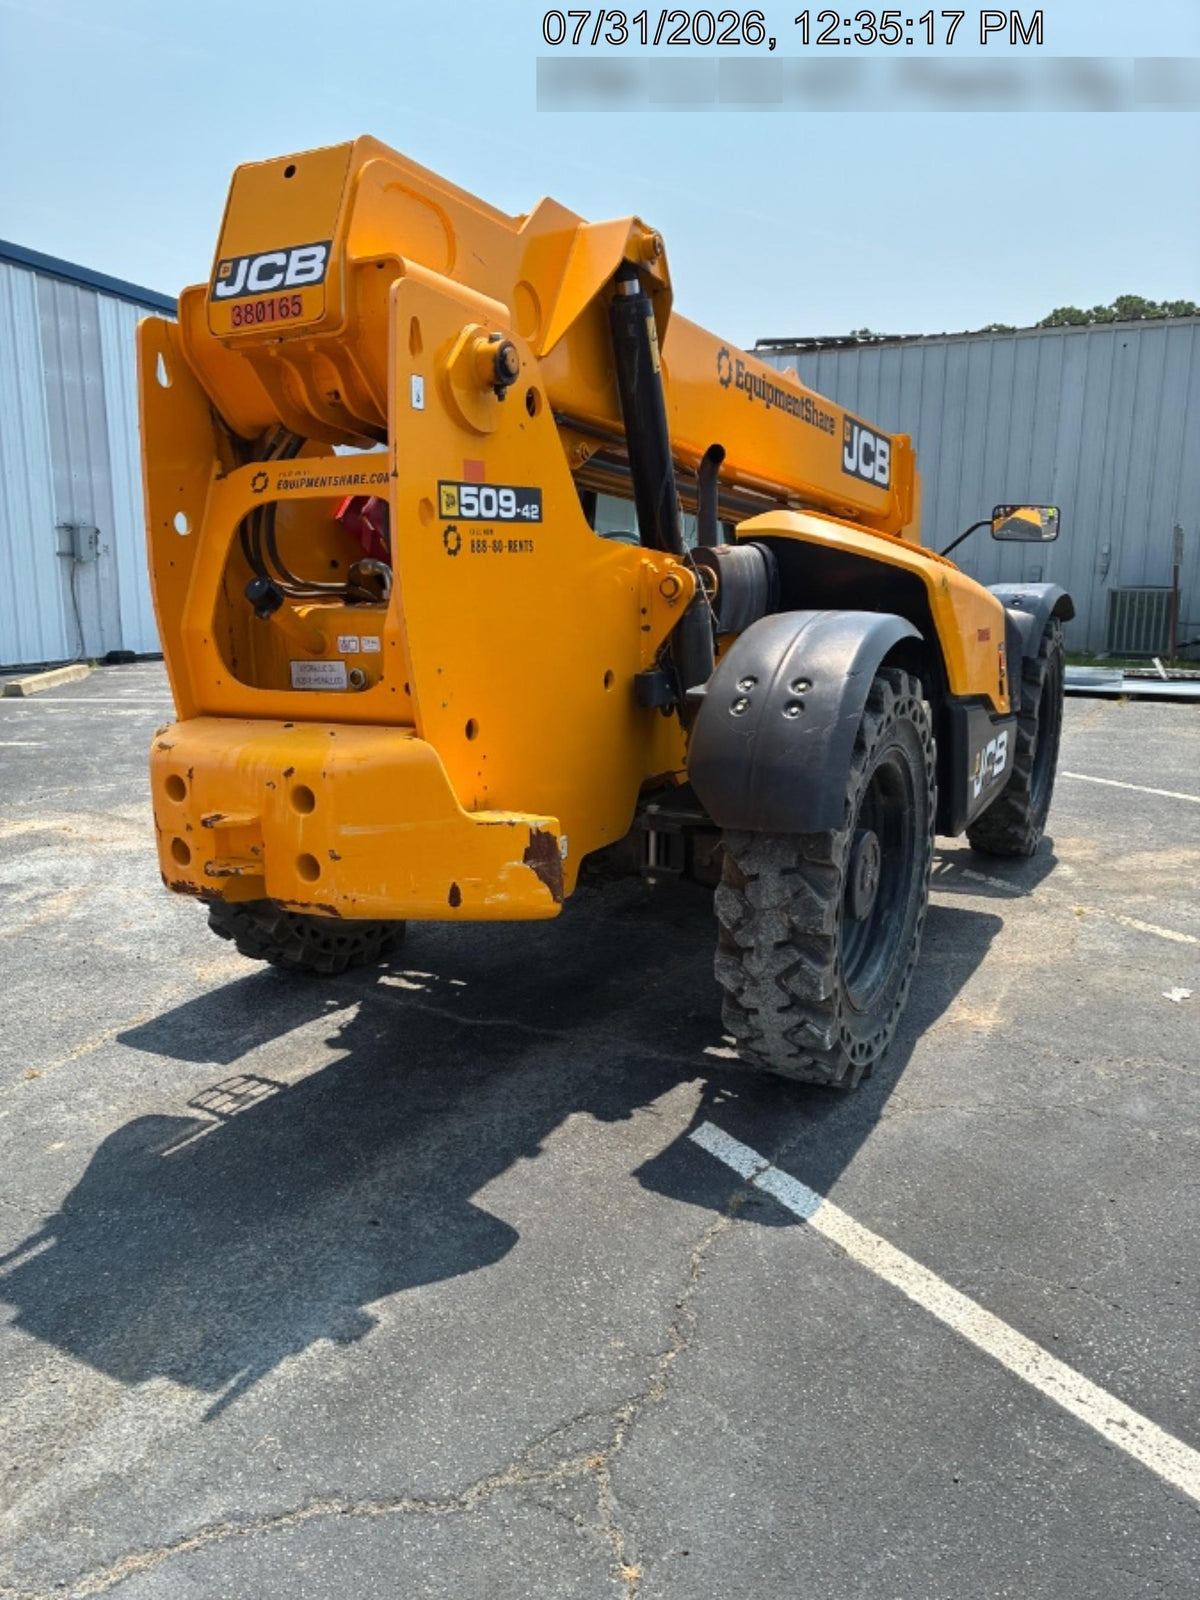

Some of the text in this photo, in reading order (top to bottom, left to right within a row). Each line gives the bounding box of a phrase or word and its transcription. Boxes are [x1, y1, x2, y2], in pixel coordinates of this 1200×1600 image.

[215, 245, 327, 297] JCB
[231, 294, 302, 327] 380165
[735, 358, 837, 436] EquipmentShare
[843, 424, 891, 486] JCB
[973, 729, 1008, 799] JCB
